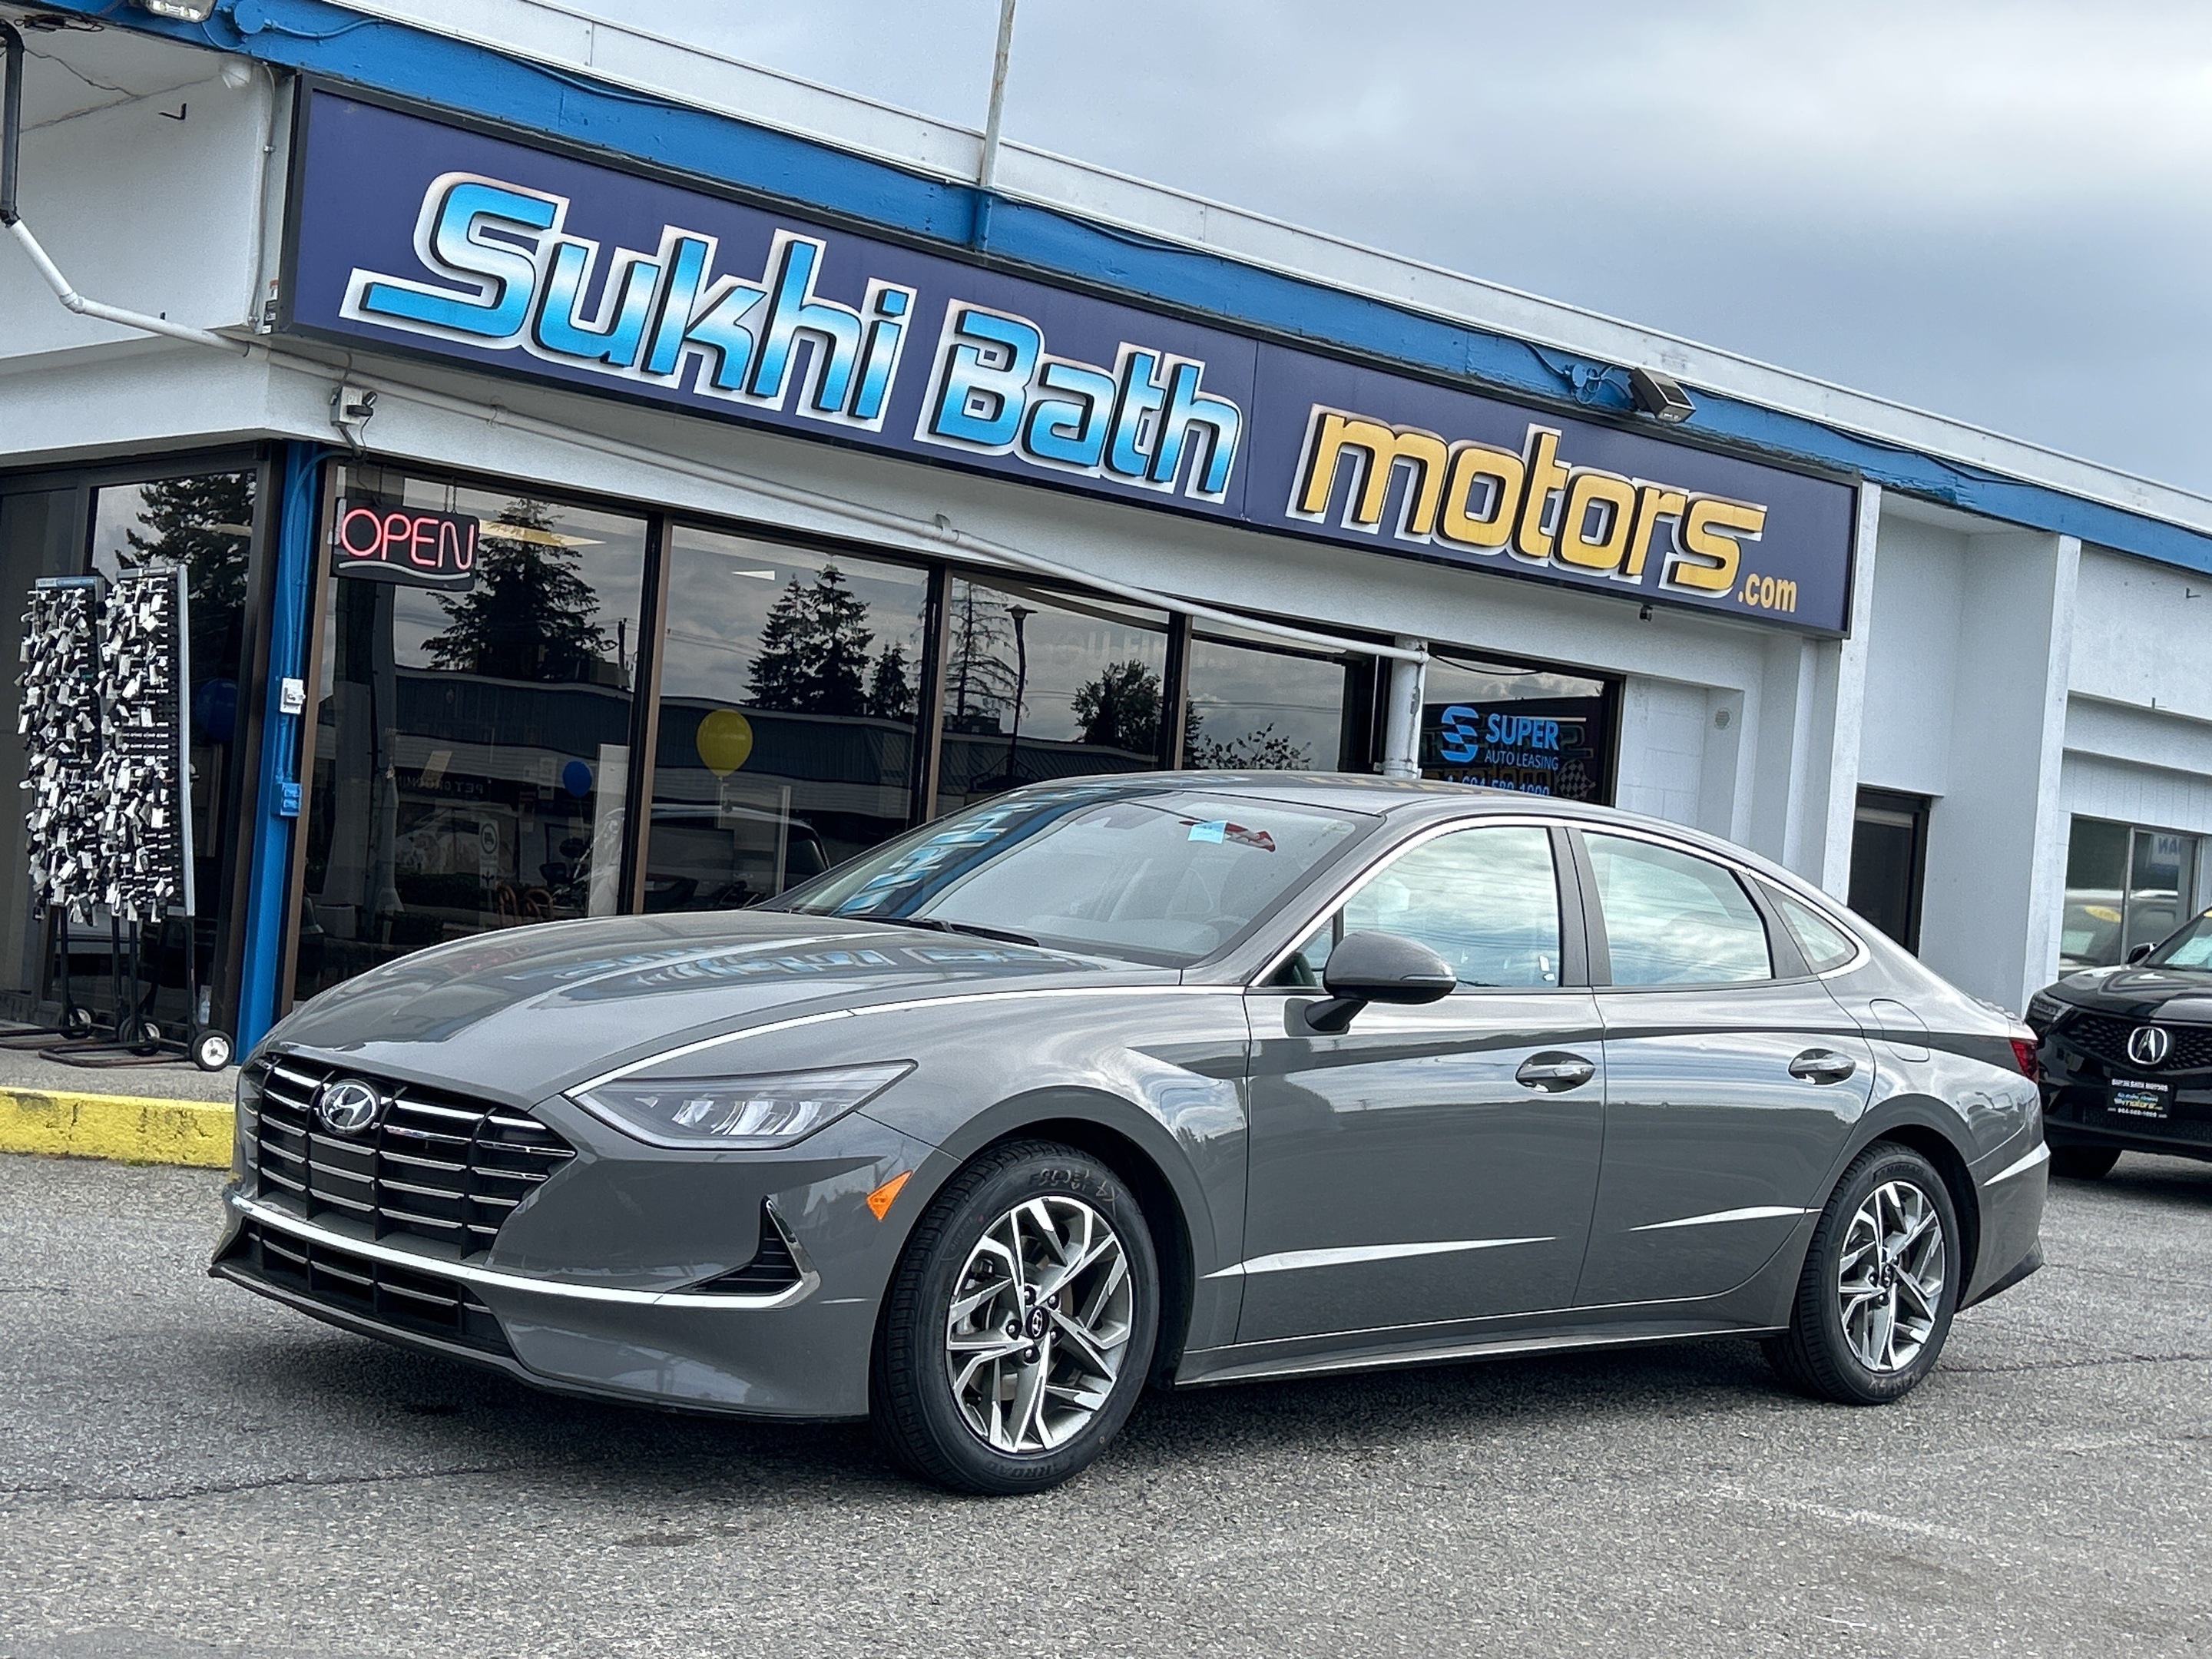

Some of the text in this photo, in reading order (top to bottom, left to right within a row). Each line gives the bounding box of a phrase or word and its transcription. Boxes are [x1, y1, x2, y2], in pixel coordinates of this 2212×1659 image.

[340, 173, 1242, 503] Sukhi Bath
[340, 508, 475, 570] OPEN
[1286, 405, 1796, 613] motors .com
[1485, 714, 1559, 750] SUPER
[1485, 750, 1559, 771] AUTO LEASING
